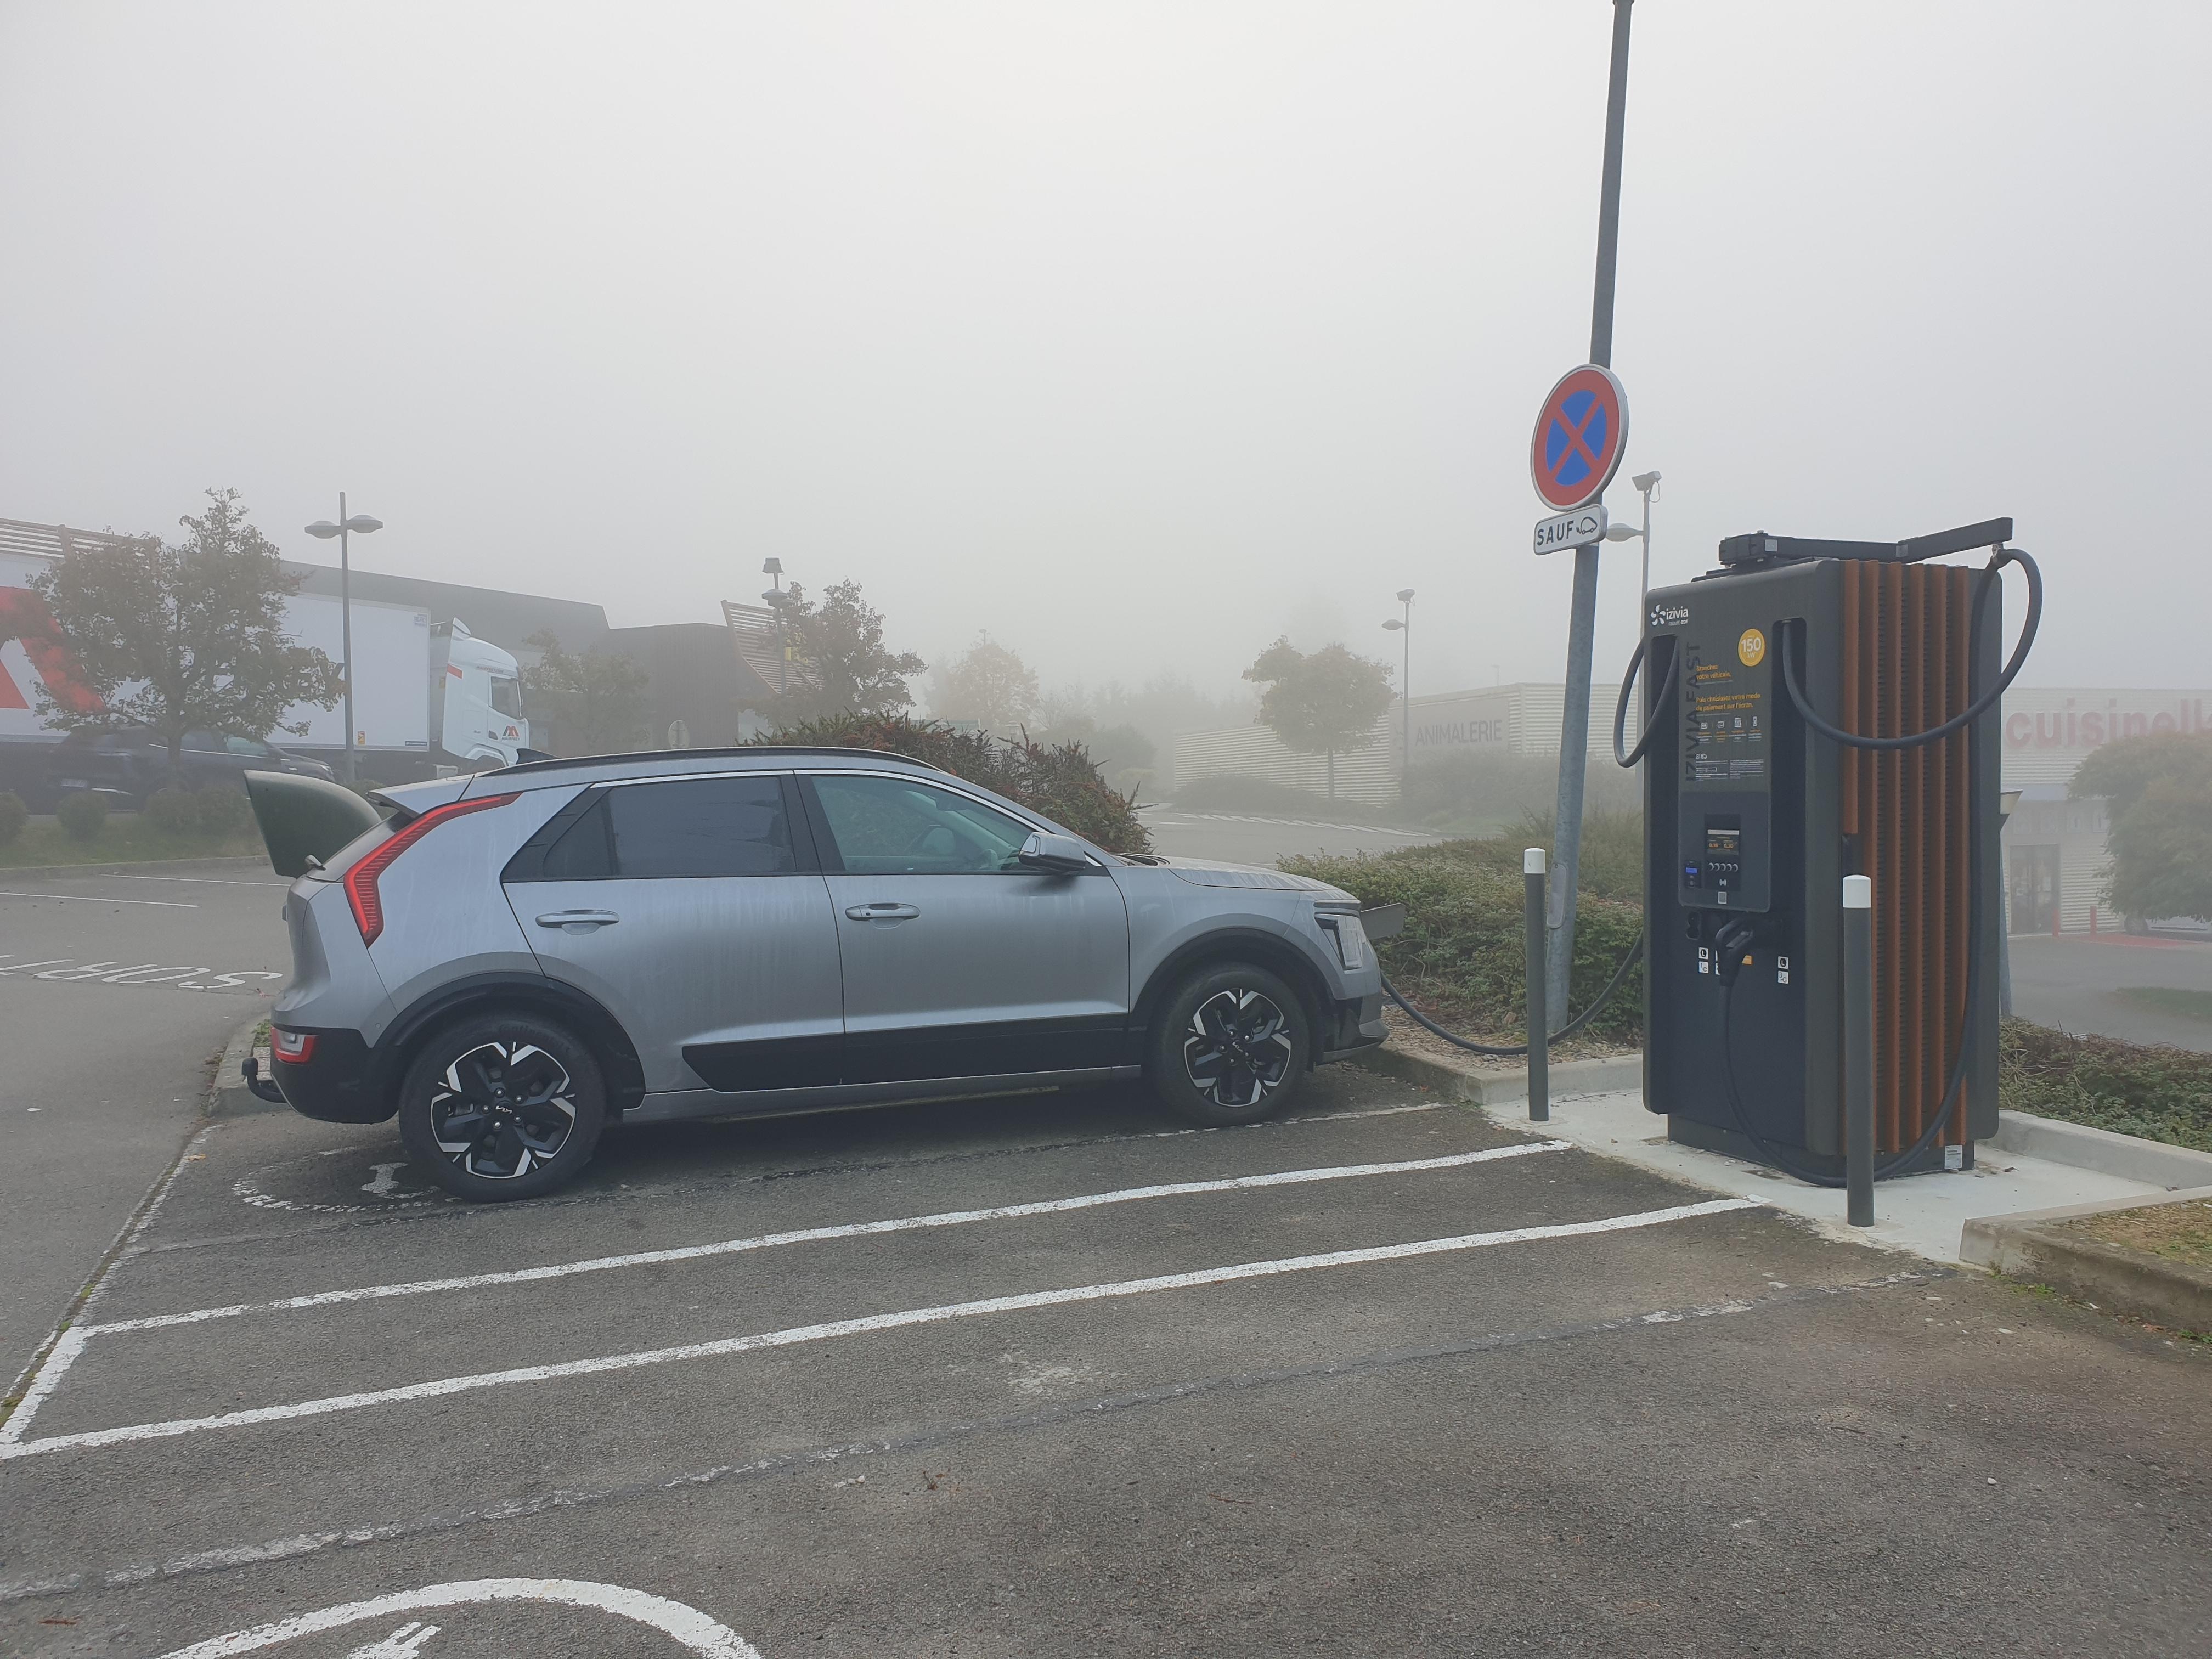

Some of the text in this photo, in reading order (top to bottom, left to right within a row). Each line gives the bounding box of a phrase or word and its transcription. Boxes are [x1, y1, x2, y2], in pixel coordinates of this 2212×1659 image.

[1537, 520, 1574, 546] SAUF
[1666, 606, 1688, 620] izivia
[1741, 637, 1762, 652] 150
[1685, 641, 1701, 782] IZIVIA FAST
[2006, 697, 2212, 748] cuisinell
[1415, 719, 1502, 747] ANIMALERIE
